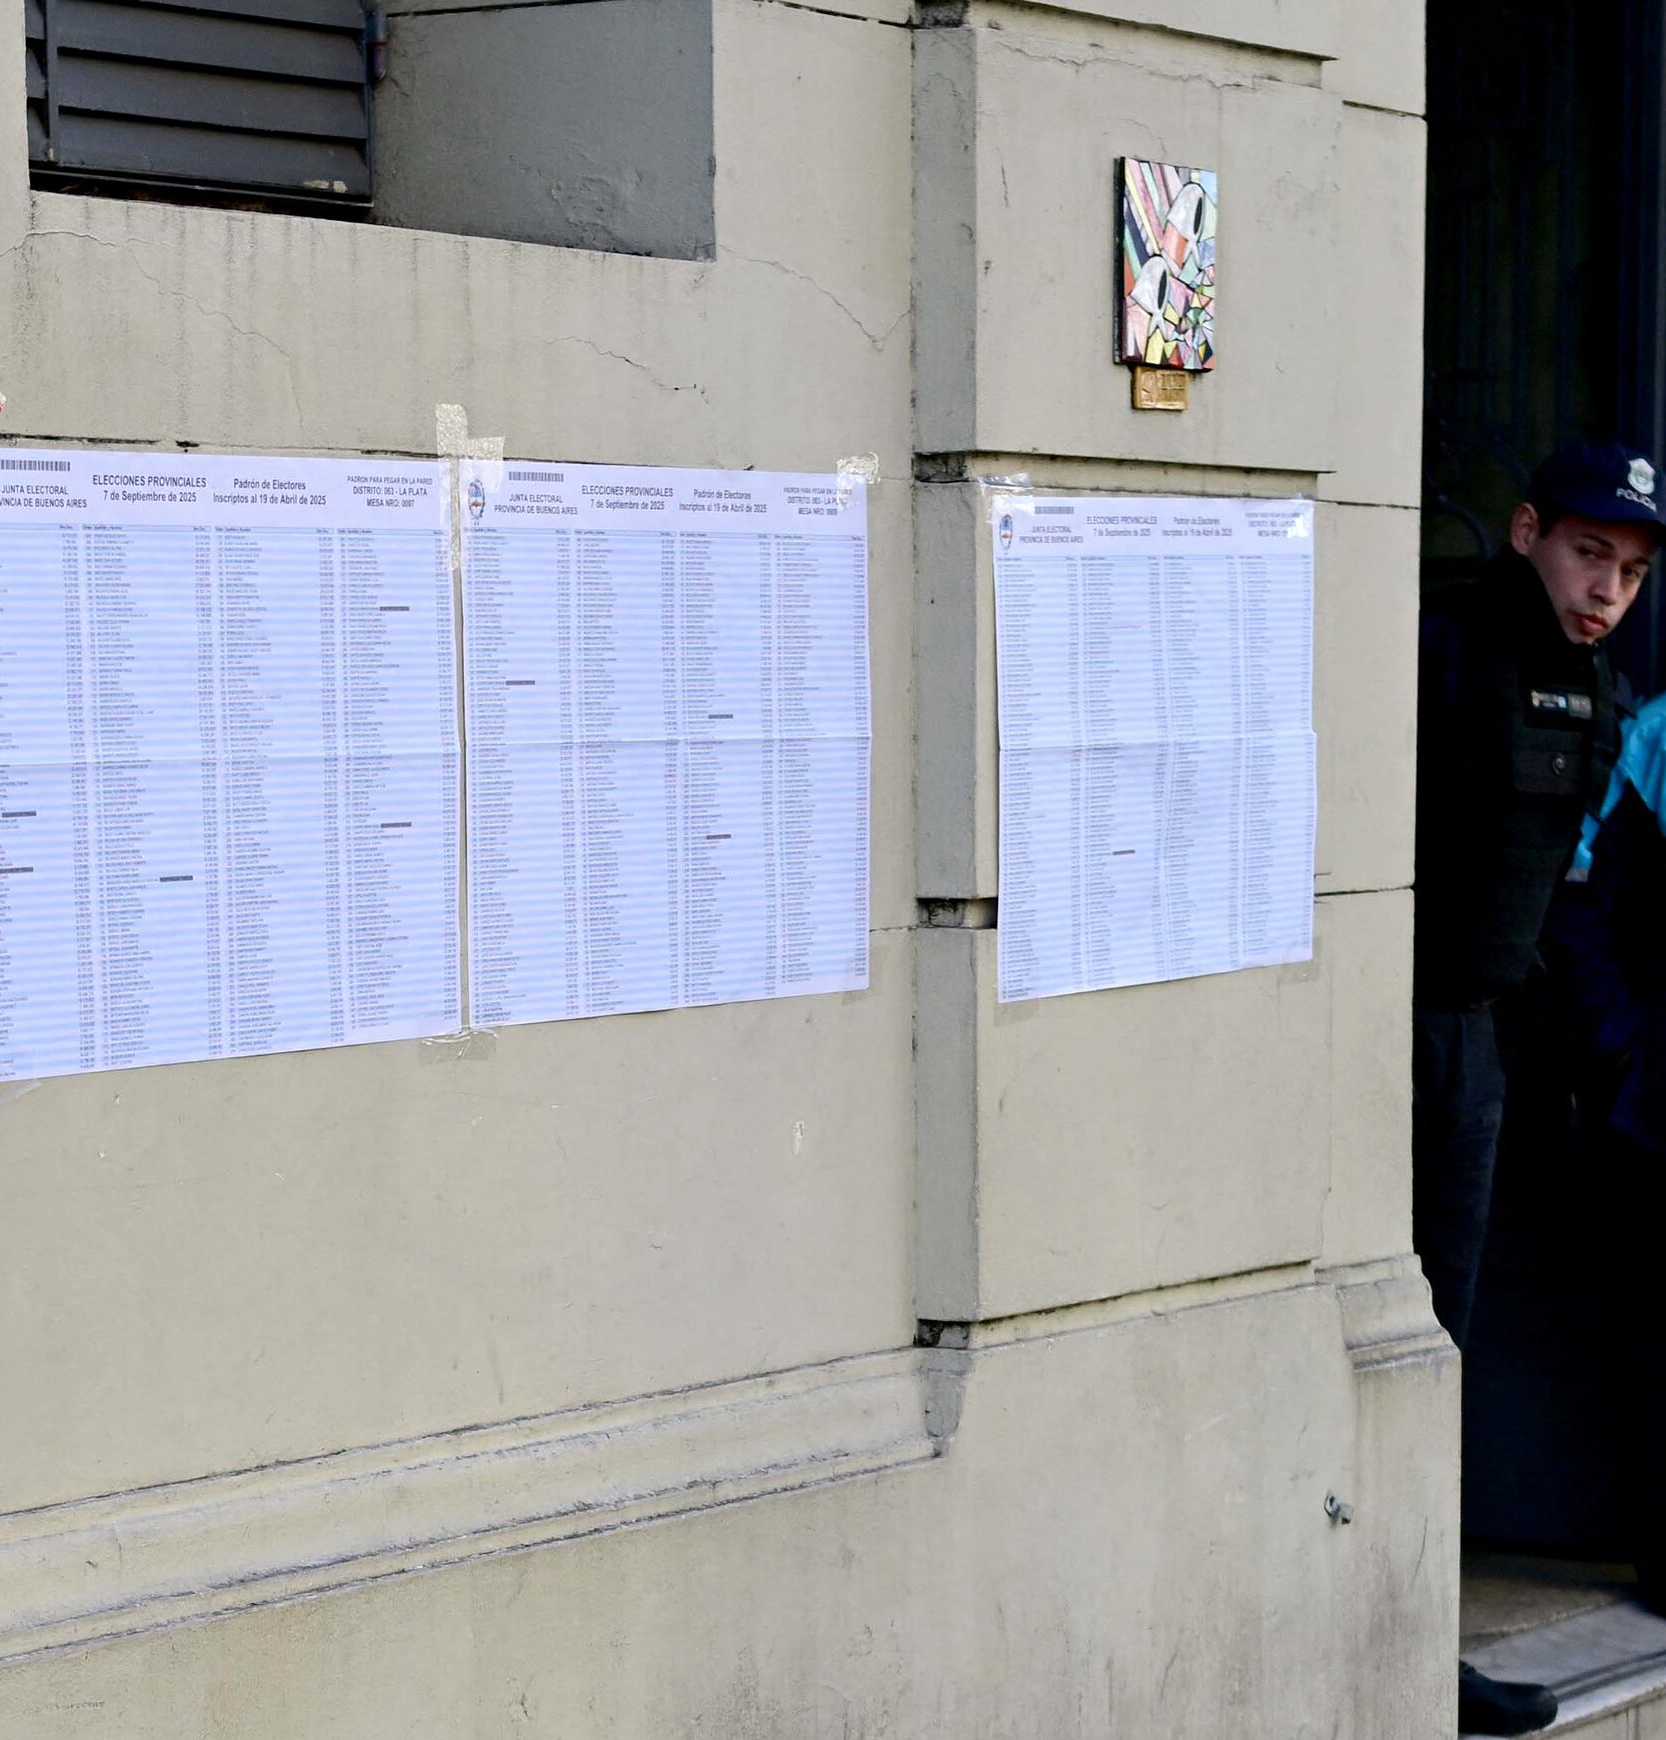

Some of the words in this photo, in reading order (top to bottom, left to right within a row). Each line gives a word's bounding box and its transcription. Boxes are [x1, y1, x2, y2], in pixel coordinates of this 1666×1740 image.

[93, 474, 146, 486] ELECCIONES
[147, 476, 207, 488] PROVINCIALES
[233, 478, 260, 489] Padrón
[261, 479, 271, 489] de
[272, 479, 306, 490] Electores
[1, 484, 24, 494] JUNTA
[26, 485, 69, 495] ELECTORAL
[582, 485, 624, 495] ELECCIONES
[625, 486, 673, 497] PROVINCIALES
[103, 490, 108, 500] 7
[110, 491, 120, 500] de
[122, 490, 166, 503] Septiembre
[168, 492, 177, 502] de
[179, 492, 197, 502] 2025
[212, 493, 249, 505] Inscriptos
[250, 494, 257, 504] al
[259, 494, 268, 504] 19
[269, 494, 279, 504] de
[280, 494, 297, 504] Abril
[299, 495, 308, 505] de
[310, 495, 327, 505] 2025
[510, 494, 528, 502] JUNTA
[529, 494, 563, 503] ELECTORAL
[23, 498, 34, 507] DE
[35, 498, 64, 508] BUENOS
[66, 499, 87, 508] AIRES
[494, 505, 525, 513] PROVINCIA
[527, 505, 535, 513] DE
[536, 506, 560, 514] BUENOS
[561, 506, 578, 515] AIRES
